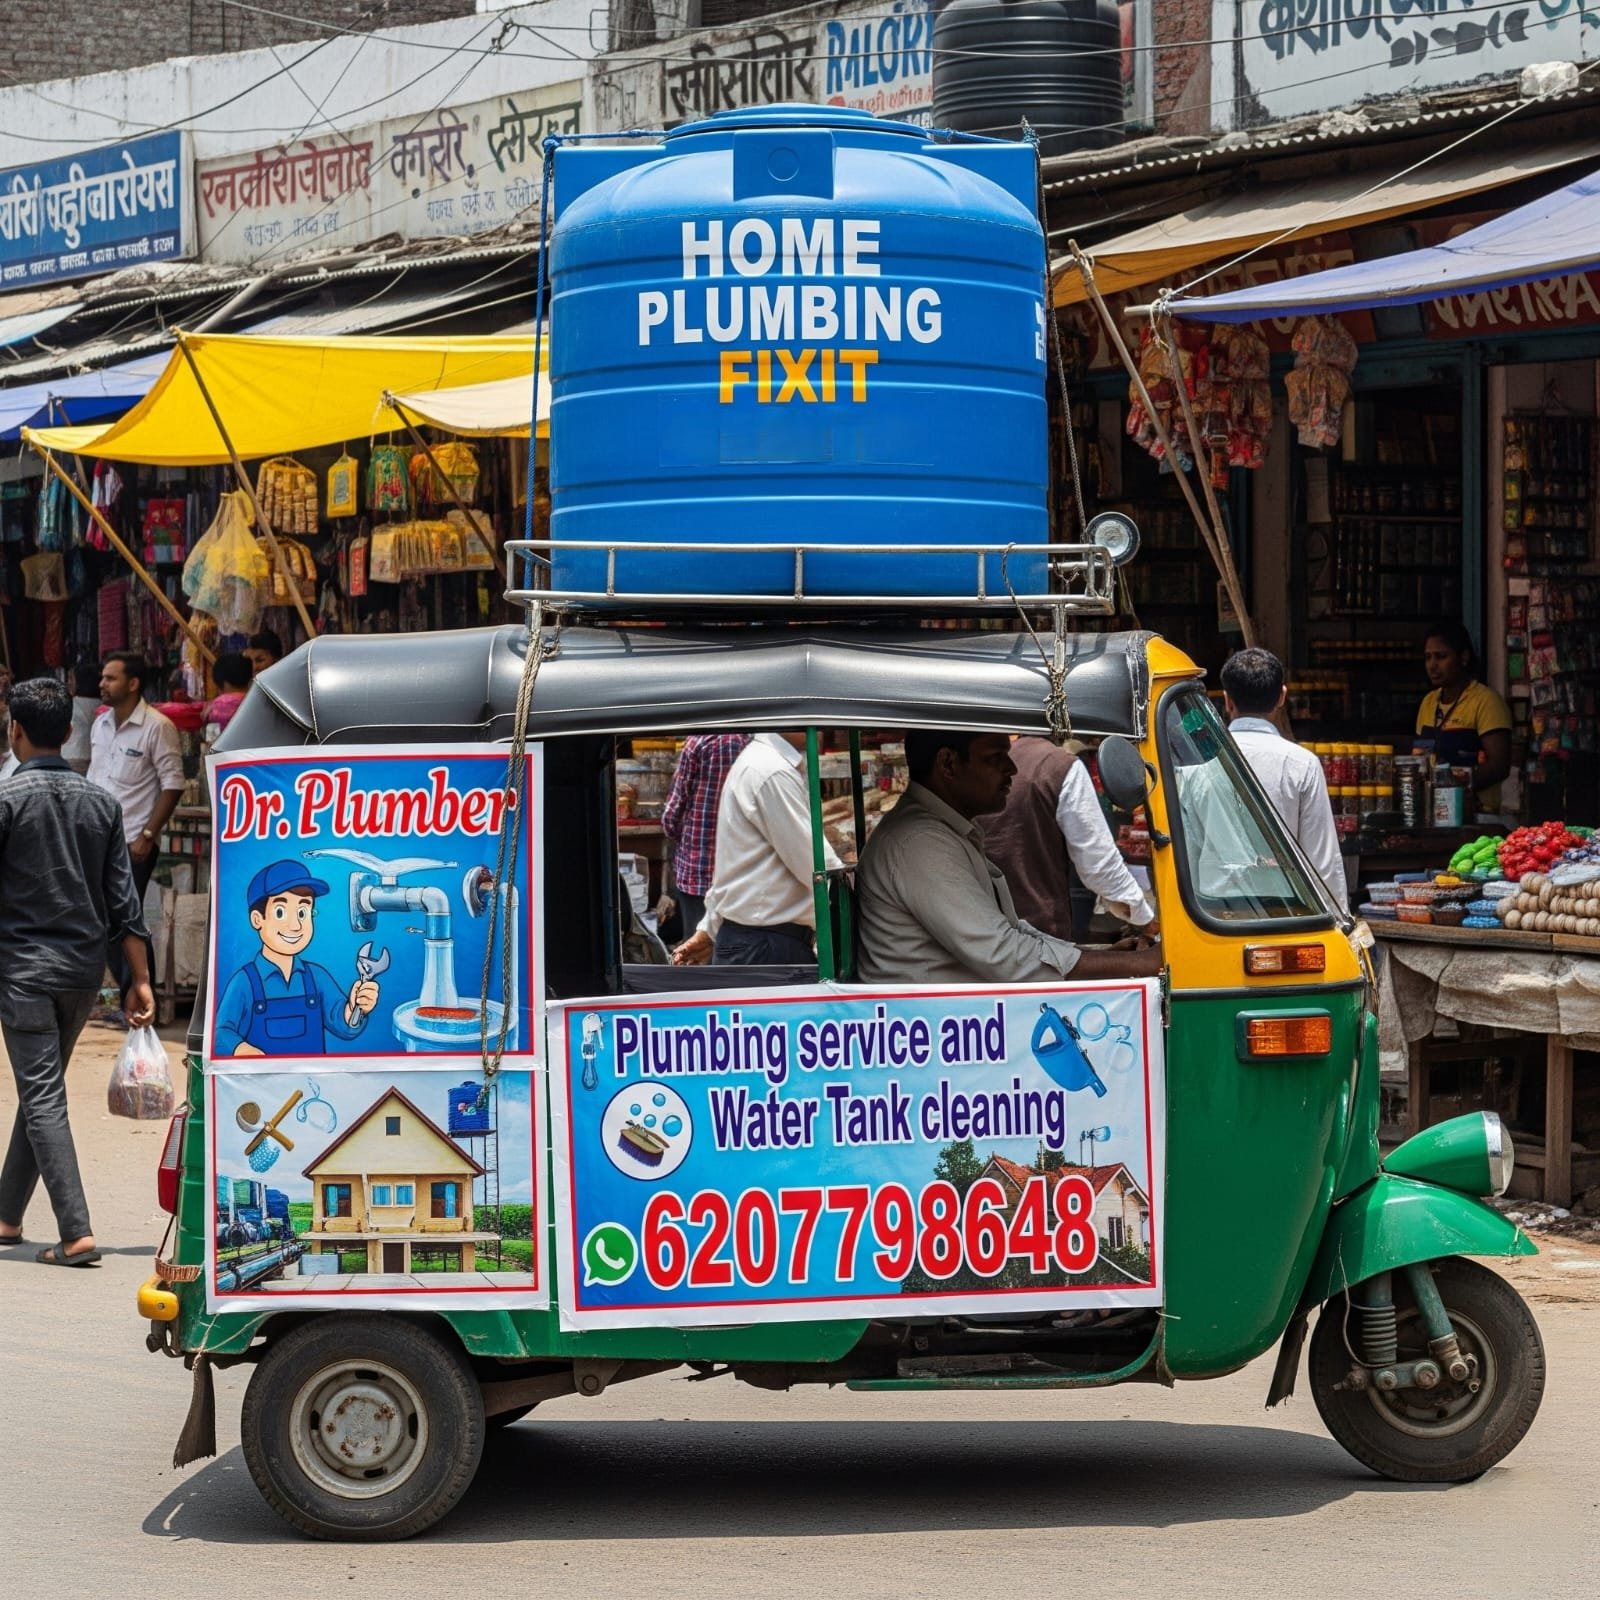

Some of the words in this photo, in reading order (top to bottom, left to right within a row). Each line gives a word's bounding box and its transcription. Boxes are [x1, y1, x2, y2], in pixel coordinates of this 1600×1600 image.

[681, 218, 881, 280] HOME
[638, 285, 942, 346] PLUMBING
[719, 349, 879, 404] FIXIT
[221, 774, 292, 843] Dr.
[296, 766, 519, 839] Plumber
[614, 1011, 788, 1084] Plumbing
[798, 1003, 930, 1071] service
[939, 1001, 1007, 1064] and
[709, 1085, 818, 1151] Water
[826, 1080, 914, 1146] Tank
[920, 1076, 1066, 1150] cleaning
[642, 1174, 1098, 1290] 6207798648
